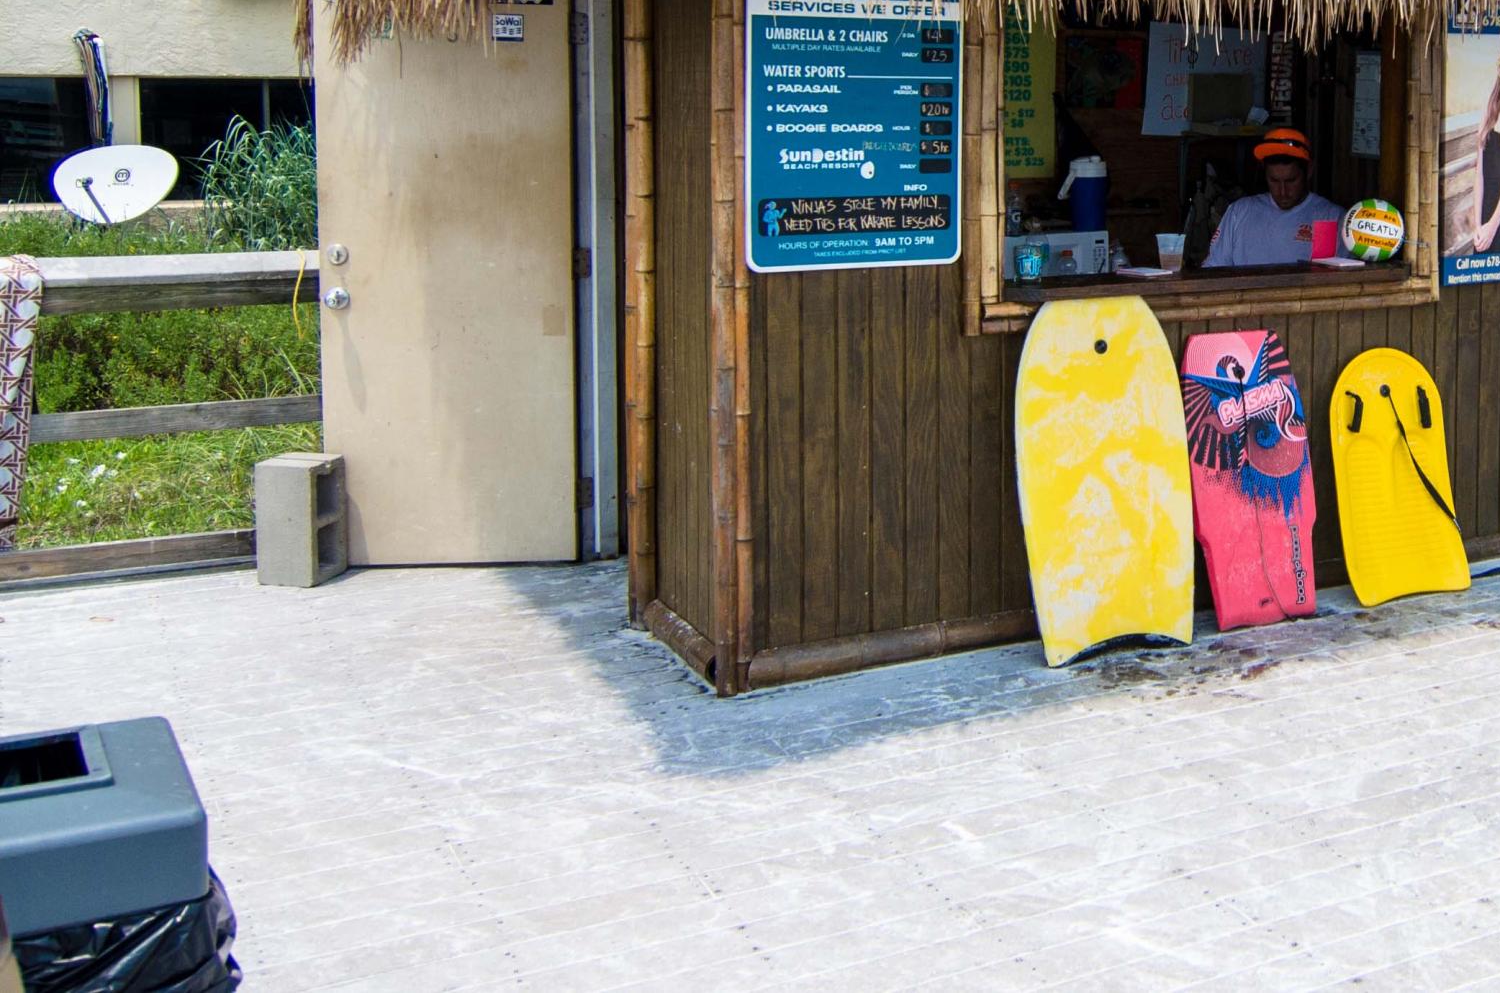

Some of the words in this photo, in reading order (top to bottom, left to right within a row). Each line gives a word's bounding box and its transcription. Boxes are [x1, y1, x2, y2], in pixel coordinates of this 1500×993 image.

[768, 0, 856, 14] SERVICES
[861, 3, 886, 16] WE
[892, 4, 946, 17] OFFER
[765, 27, 825, 42] UMBRELLA
[827, 29, 837, 42] &
[839, 29, 846, 42] 2
[849, 30, 889, 43] CHAIRS
[772, 43, 806, 51] MULTIPLE
[807, 44, 821, 52] DAY
[822, 44, 845, 52] RATES
[846, 45, 882, 53] AVAILABLE
[763, 65, 801, 78] WATER
[804, 65, 846, 78] SPORTS
[776, 84, 841, 93] PARASAIL
[776, 104, 828, 113] KAYAKS
[776, 124, 827, 133] BOOGIE
[831, 124, 884, 133] BOARDS
[779, 148, 864, 163] SunDestin
[904, 184, 928, 192] INFO
[778, 241, 807, 250] HOURS
[809, 240, 821, 249] OF
[875, 237, 896, 247] 9AM
[899, 236, 912, 246] TO
[914, 235, 934, 245] 5PM
[1456, 258, 1470, 270] Call
[1470, 259, 1486, 268] now
